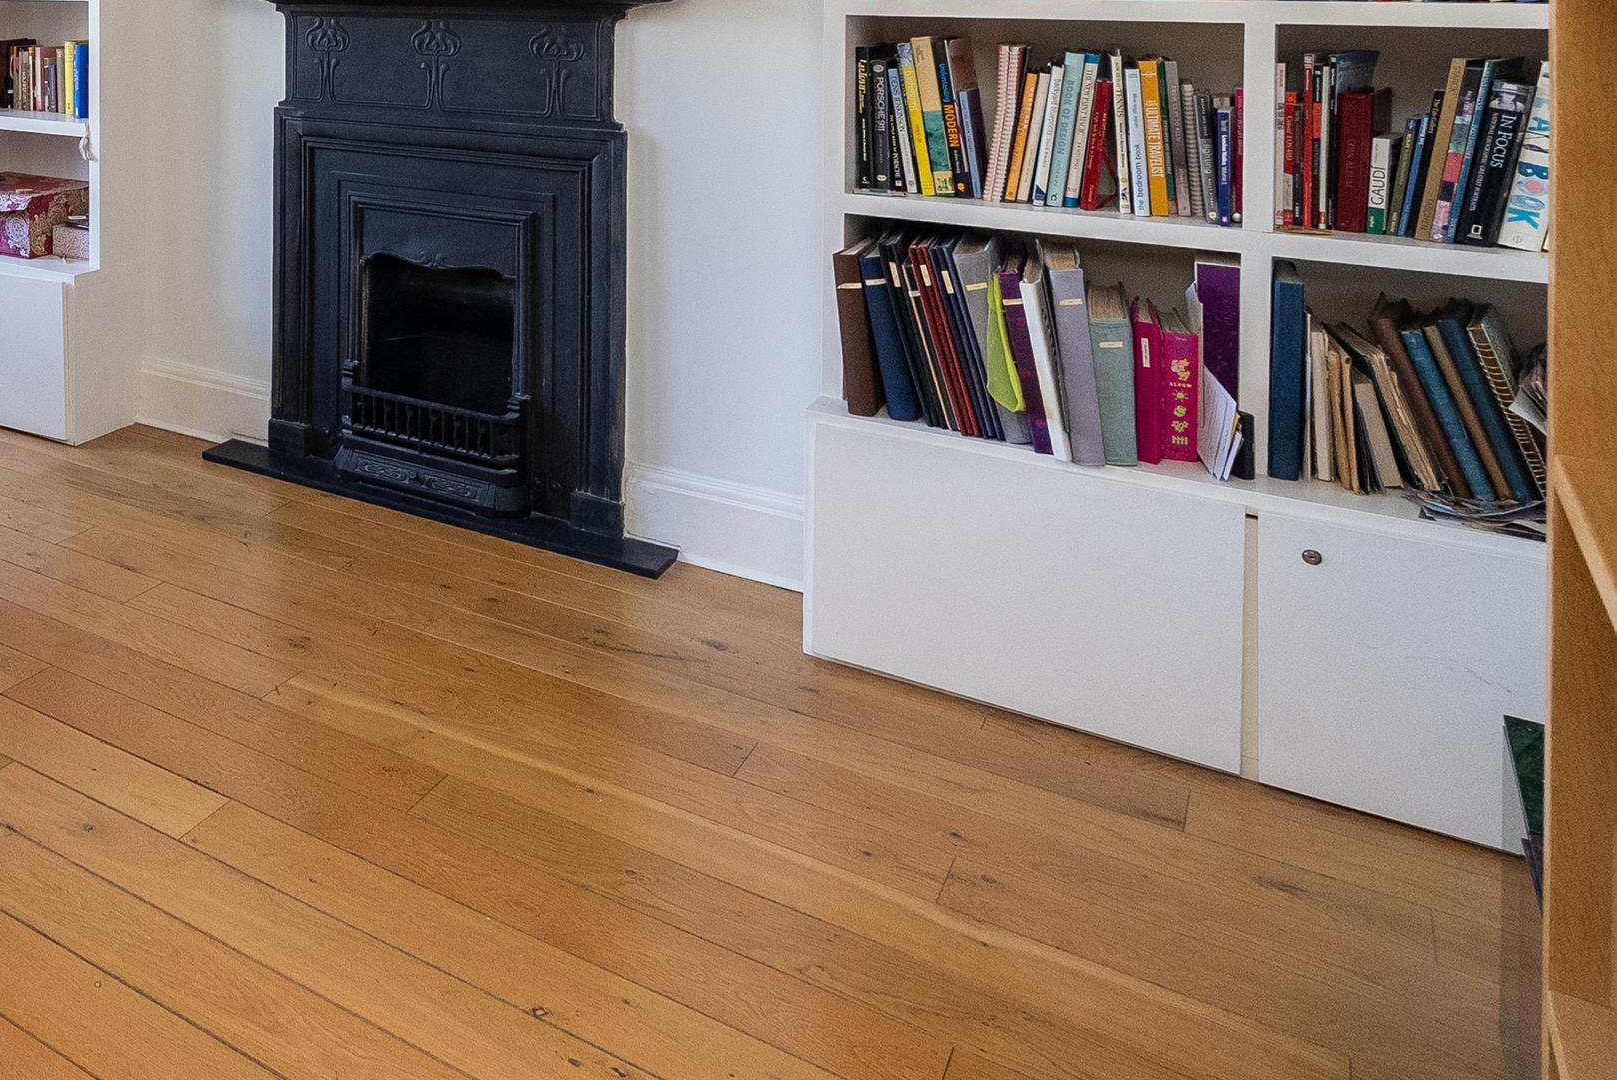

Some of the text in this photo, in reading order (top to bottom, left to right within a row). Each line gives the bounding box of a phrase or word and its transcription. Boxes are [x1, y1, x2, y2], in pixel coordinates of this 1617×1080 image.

[943, 104, 959, 147] MODERN
[1057, 79, 1074, 155] BOOK OF DESIGN
[1145, 106, 1163, 178] ULTIMATE TRAVELIST
[1202, 143, 1213, 175] lighting
[1490, 115, 1517, 169] IN FOCUS
[1135, 162, 1144, 198] bedroom
